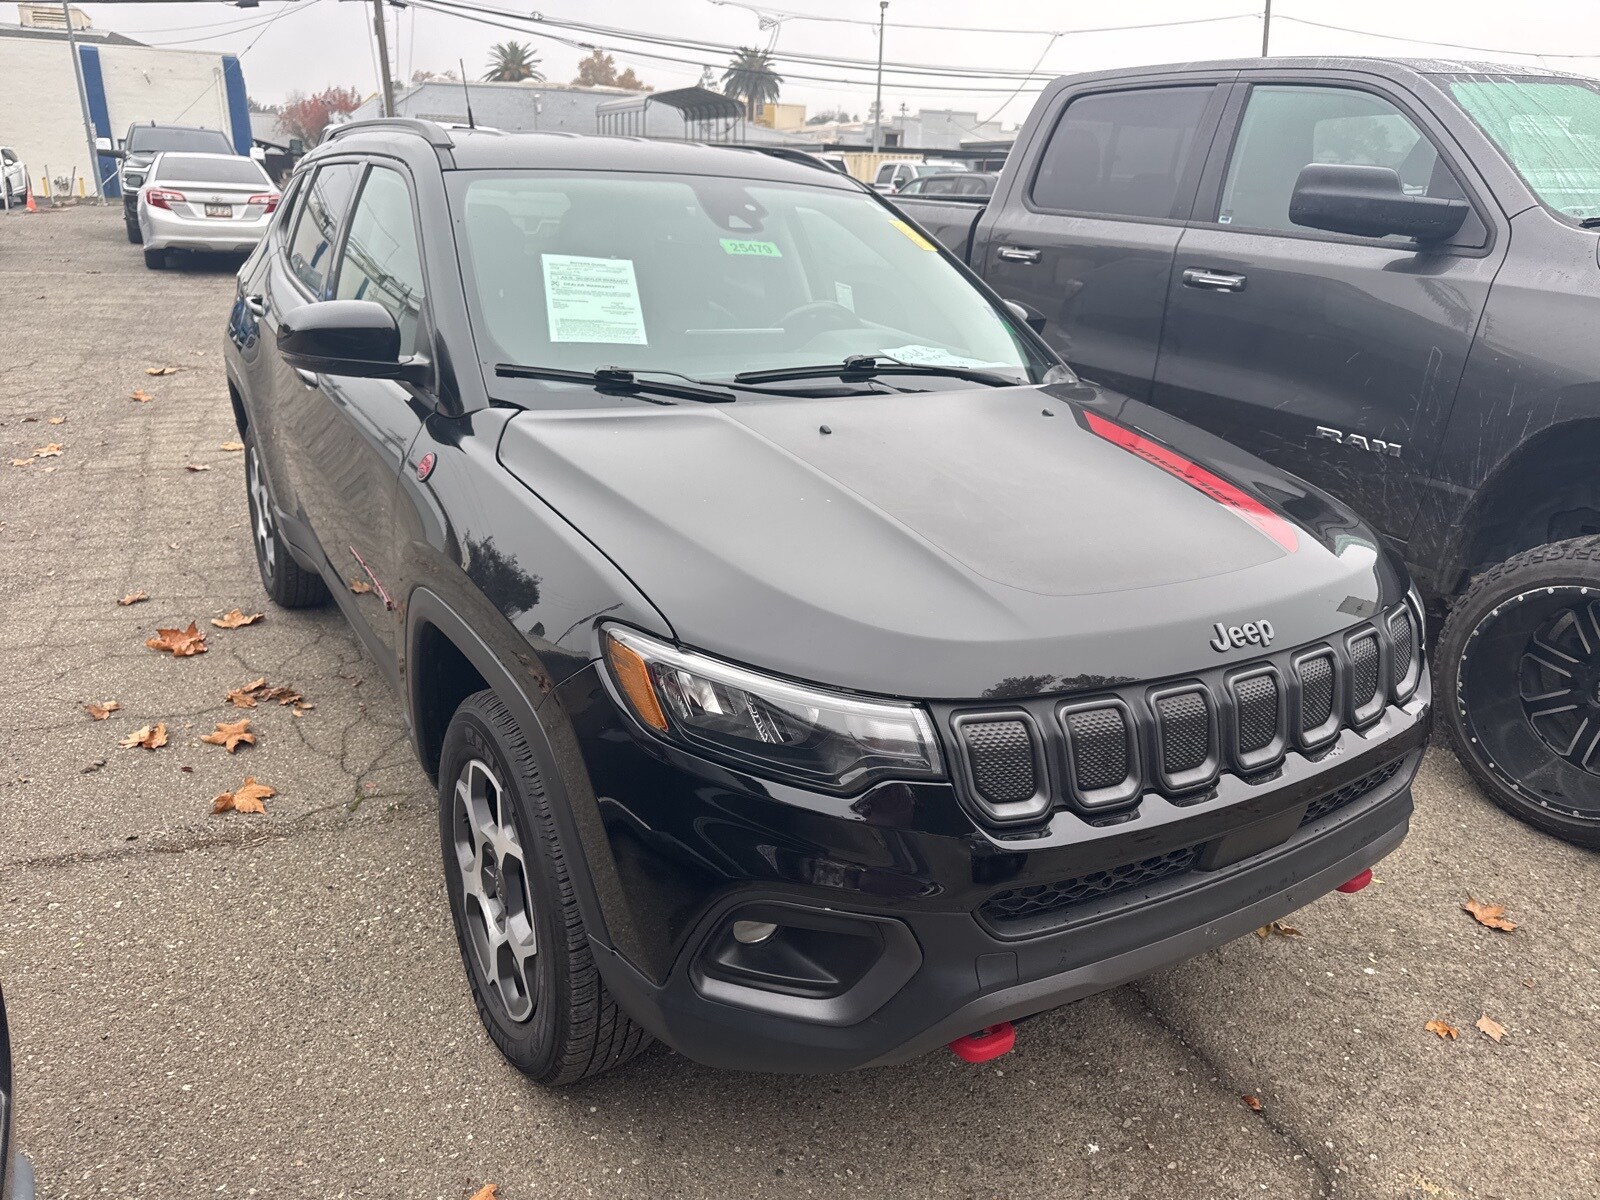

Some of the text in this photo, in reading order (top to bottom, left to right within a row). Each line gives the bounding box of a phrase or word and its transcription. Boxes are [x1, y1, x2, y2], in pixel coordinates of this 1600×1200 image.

[729, 242, 773, 254] 25479
[1315, 425, 1402, 458] RAM
[1209, 619, 1275, 653] Jeep
